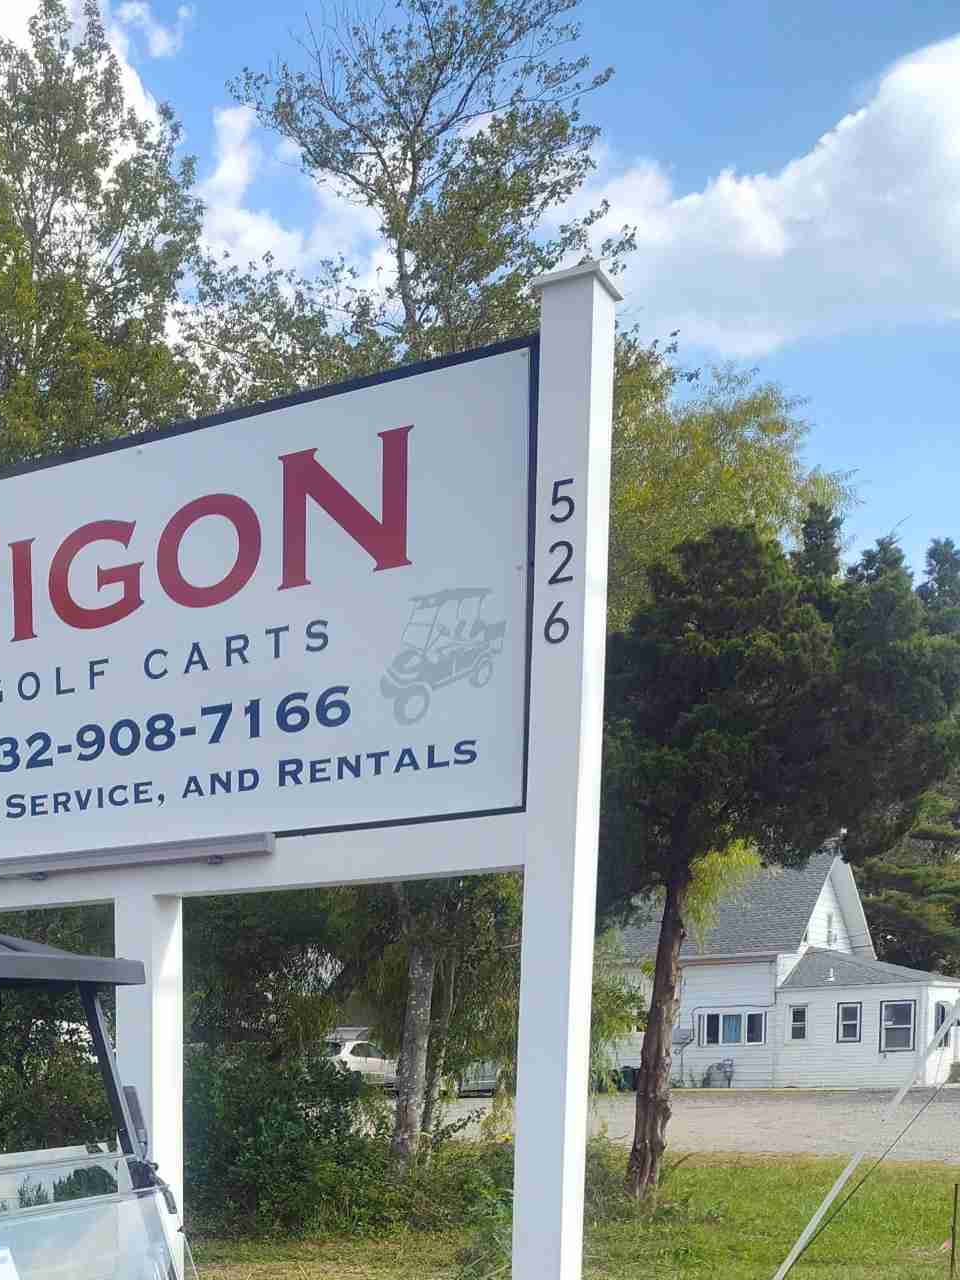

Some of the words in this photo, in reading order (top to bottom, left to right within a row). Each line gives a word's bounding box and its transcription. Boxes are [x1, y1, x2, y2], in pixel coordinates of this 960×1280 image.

[143, 619, 329, 681] CARTS
[4, 782, 166, 820] SERVICE,
[277, 739, 478, 788] RENTALS
